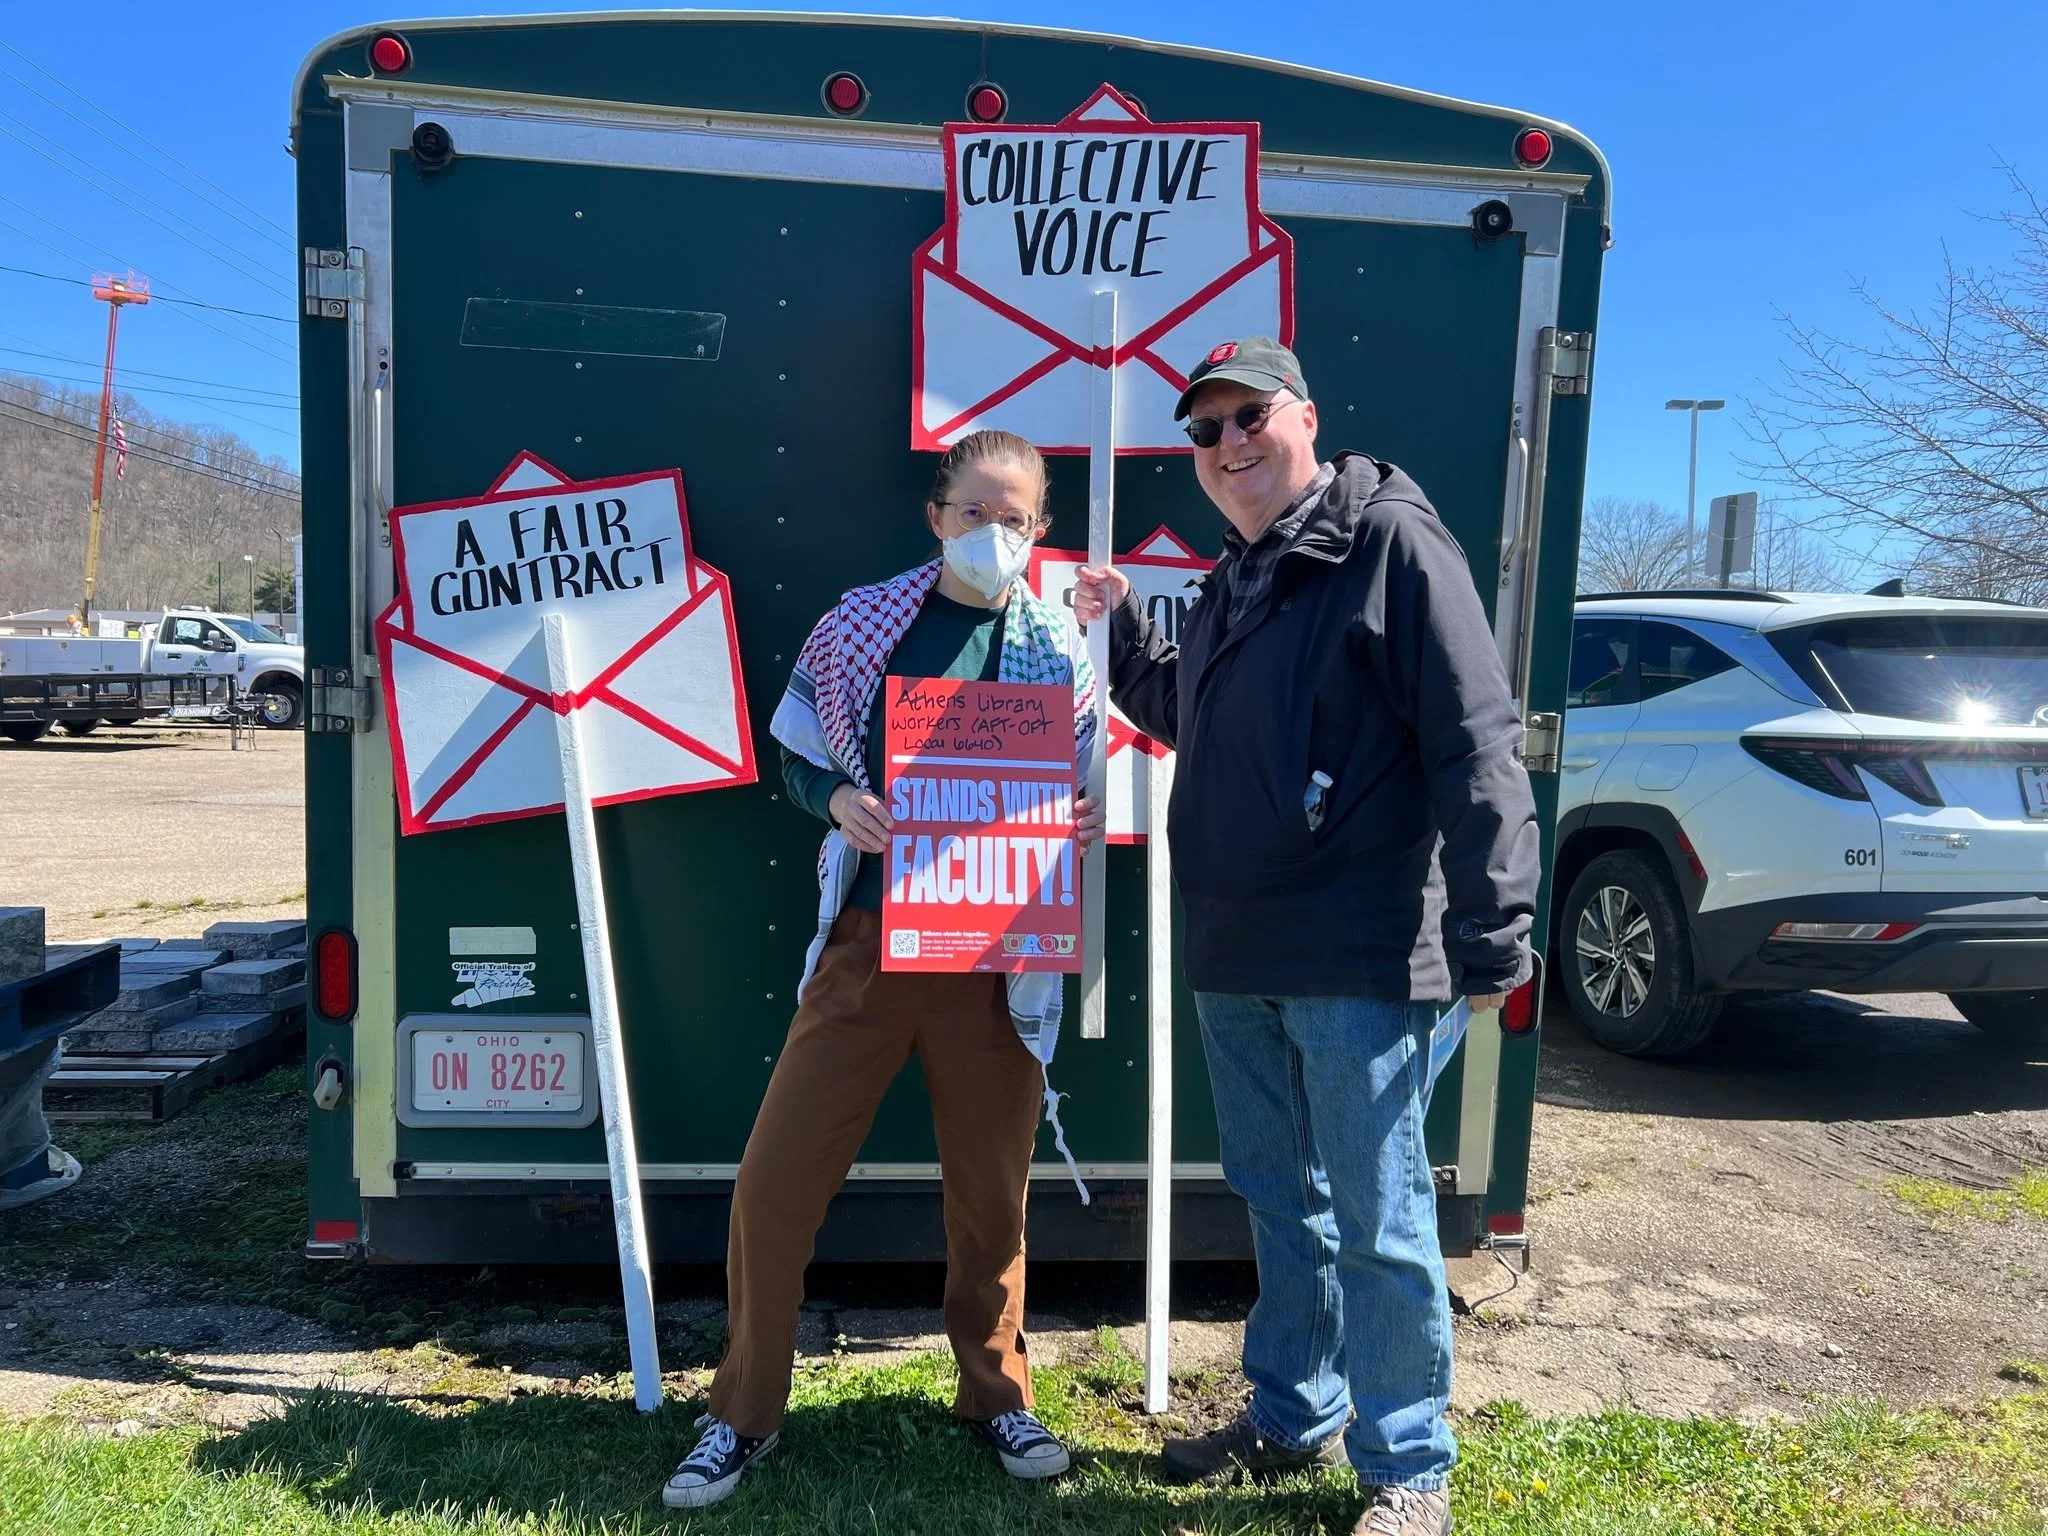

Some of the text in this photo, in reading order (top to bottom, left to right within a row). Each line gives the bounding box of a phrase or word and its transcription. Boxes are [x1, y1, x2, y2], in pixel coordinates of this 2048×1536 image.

[962, 138, 1230, 206] COLLECTIVE
[1013, 208, 1170, 277] VOICE
[455, 498, 631, 568] A FAIR
[895, 689, 966, 711] Athens
[891, 776, 1074, 825] STANDS WITH
[891, 834, 1075, 906] FACULTY!
[1844, 848, 1877, 866] 601
[478, 977, 531, 992] Racing
[477, 1036, 520, 1047] OHIO
[432, 1053, 566, 1091] ON 8262
[486, 1099, 510, 1108] CITY
